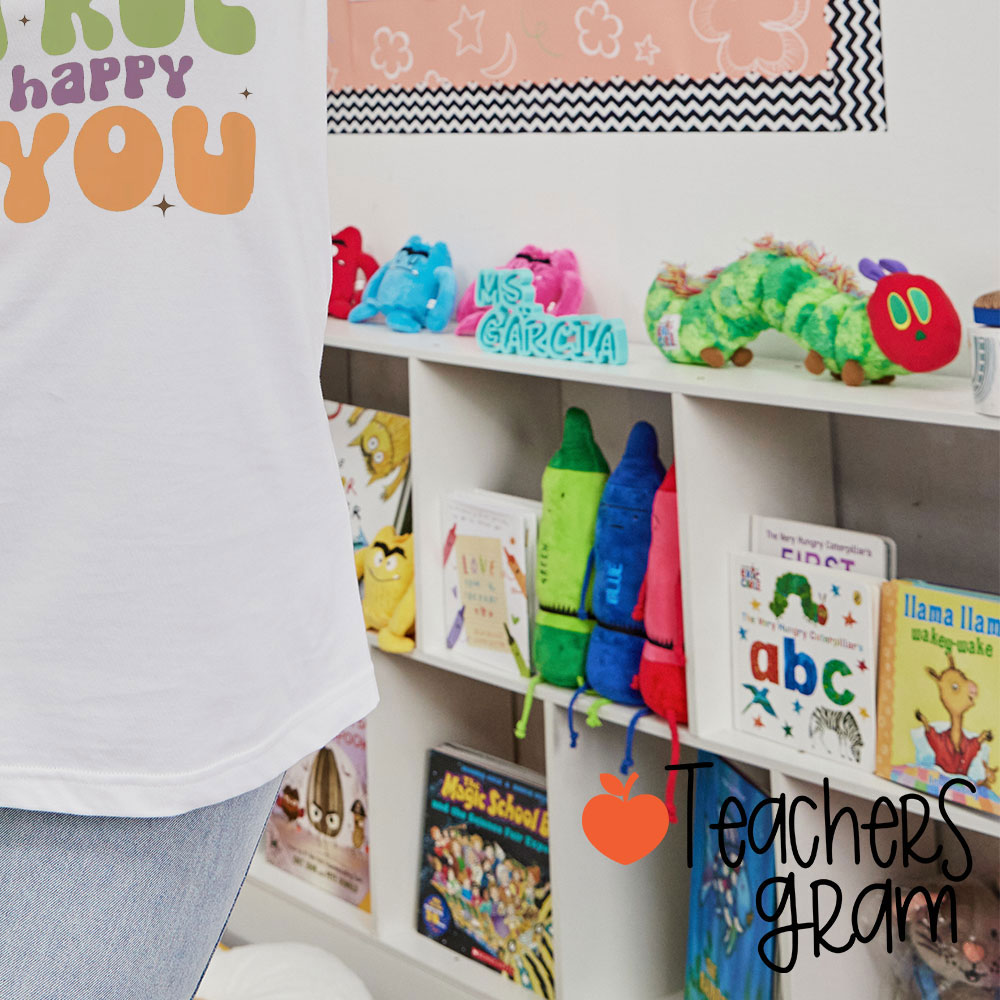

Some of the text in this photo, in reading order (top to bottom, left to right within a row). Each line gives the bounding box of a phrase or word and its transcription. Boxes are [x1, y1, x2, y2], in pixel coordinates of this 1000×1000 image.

[9, 54, 194, 112] happy
[479, 314, 618, 365] GARCIA
[904, 594, 1000, 638] llama llam
[911, 625, 994, 658] wakey-wake
[750, 636, 856, 706] abc
[440, 772, 487, 811] Magic
[486, 788, 541, 832] School
